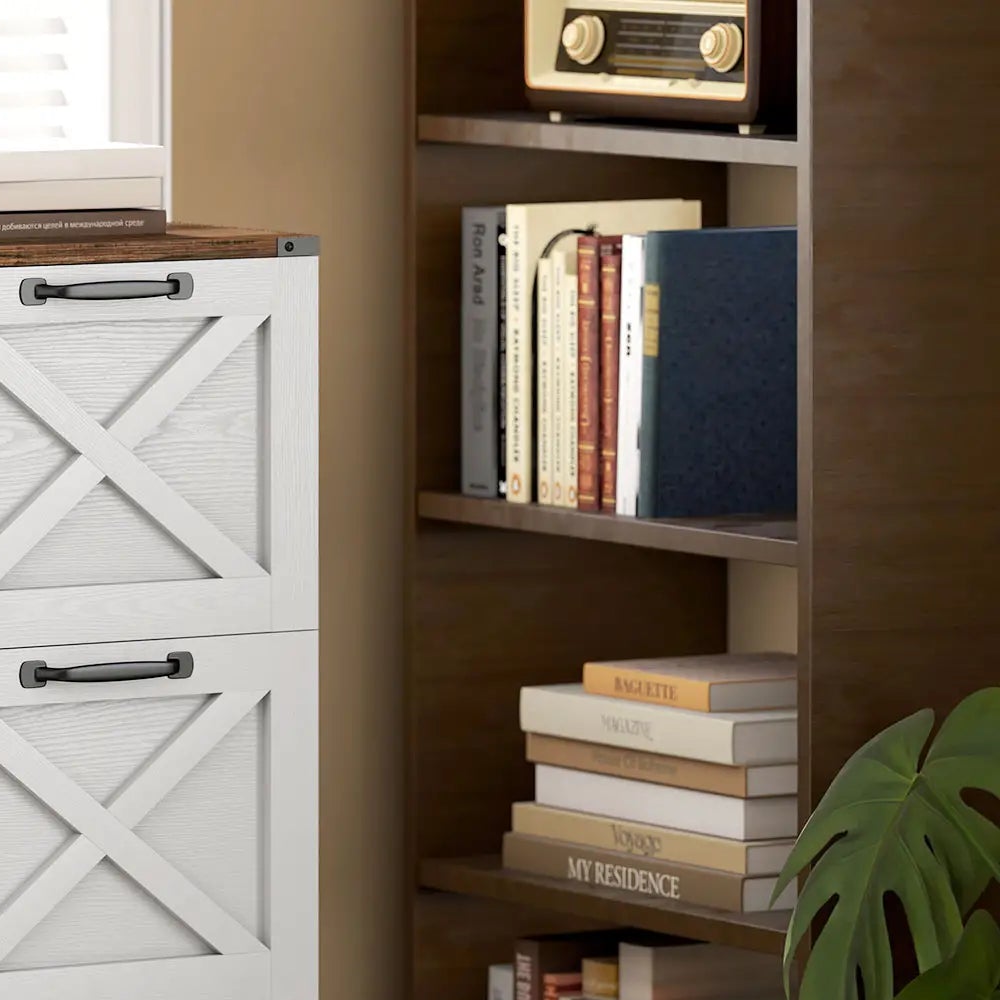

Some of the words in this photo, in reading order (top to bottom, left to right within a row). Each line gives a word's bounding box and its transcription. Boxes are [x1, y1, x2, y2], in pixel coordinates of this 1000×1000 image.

[2, 223, 41, 231] добиваются
[43, 221, 63, 230] целей
[70, 220, 123, 228] международной
[472, 224, 486, 258] Ron
[472, 265, 486, 305] Arad
[614, 676, 678, 701] BAGUETTE
[610, 824, 662, 856] Voyage
[567, 856, 592, 882] MY
[595, 861, 680, 899] RESIDENCE
